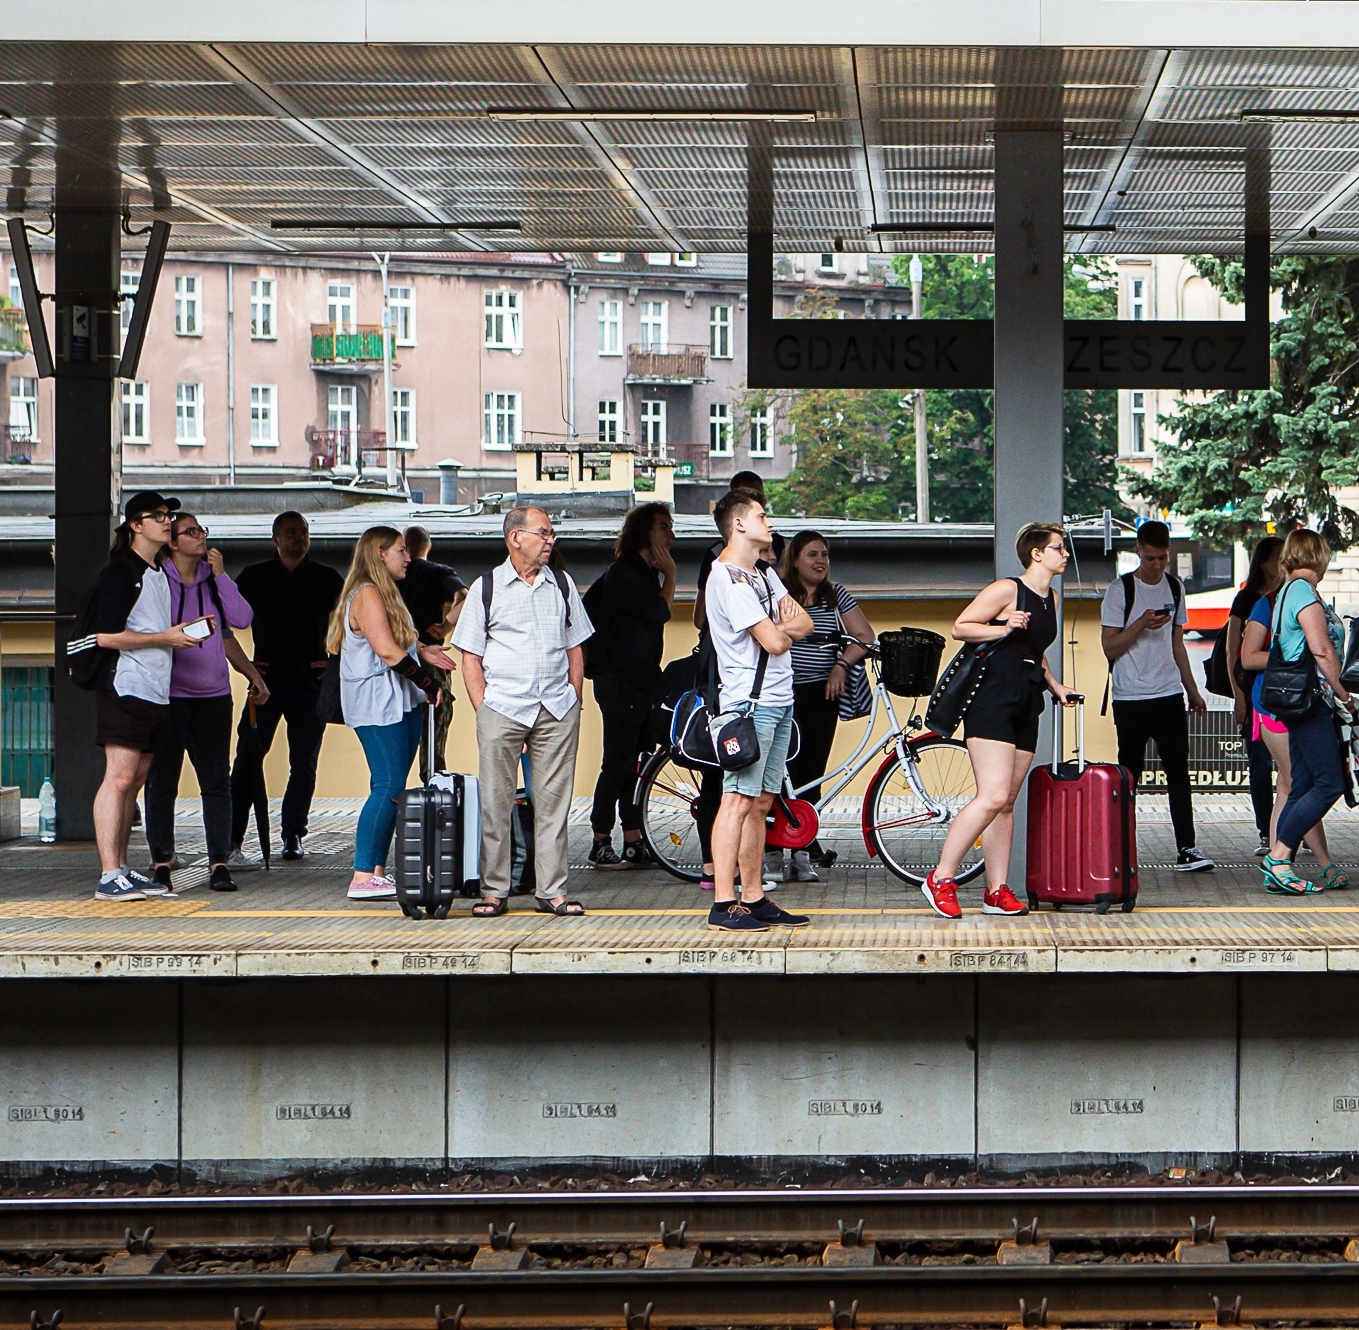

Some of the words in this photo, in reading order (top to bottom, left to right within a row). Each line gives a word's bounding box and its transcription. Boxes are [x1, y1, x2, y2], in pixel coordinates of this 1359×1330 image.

[773, 326, 960, 372] GDAŃSK
[1067, 336, 1247, 373] ZESZCZ
[1217, 741, 1243, 751] TOP
[1261, 952, 1276, 963] 97
